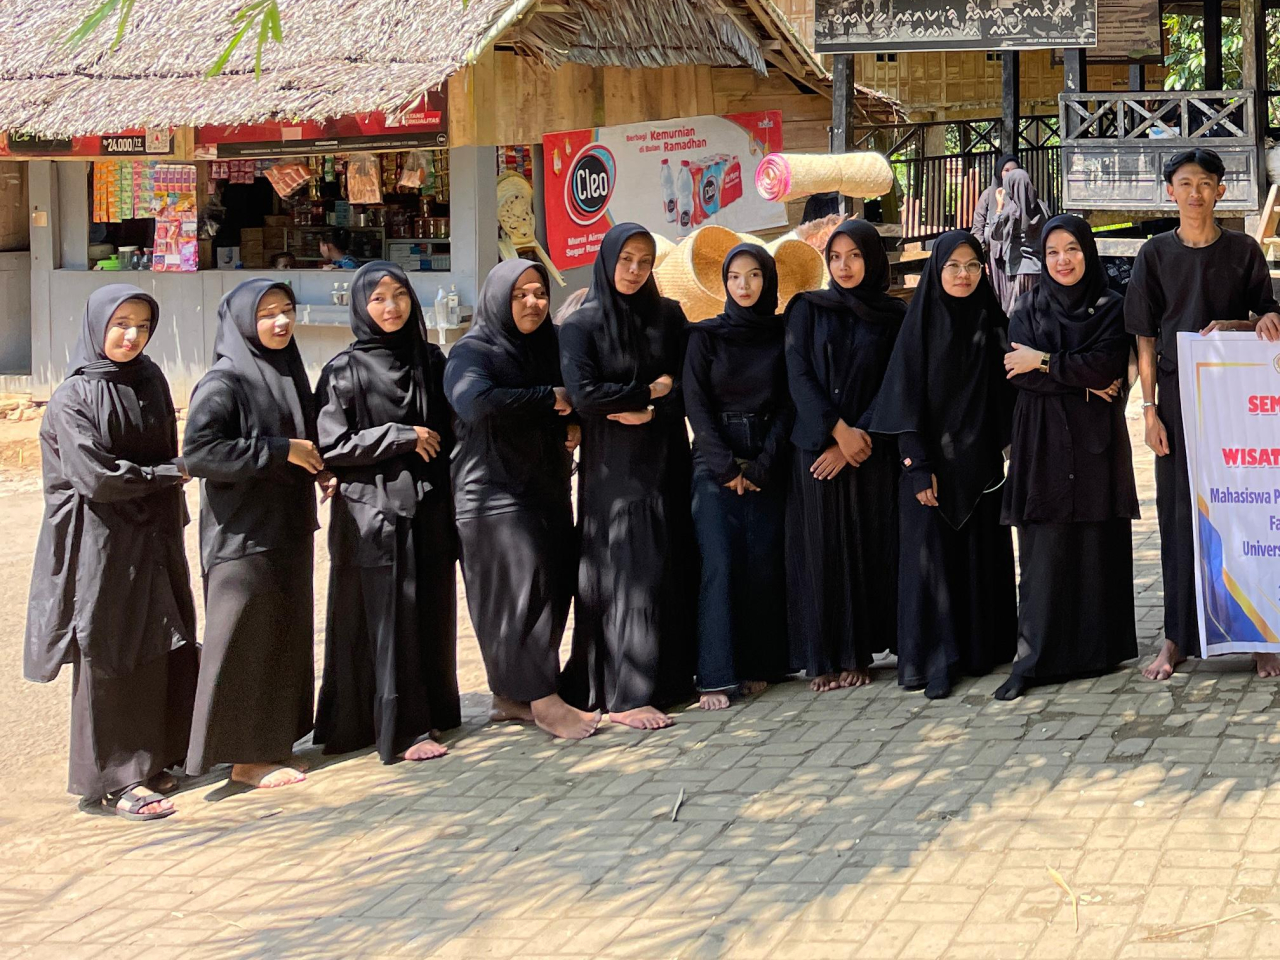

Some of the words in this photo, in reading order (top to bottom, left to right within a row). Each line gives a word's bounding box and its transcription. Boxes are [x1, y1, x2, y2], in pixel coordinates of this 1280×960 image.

[626, 132, 648, 142] Berbagi
[650, 126, 695, 140] Kemurnian
[638, 145, 645, 153] di
[645, 144, 660, 153] Bulan
[663, 138, 707, 152] Ramadhan
[576, 168, 608, 200] Cleo
[1210, 488, 1271, 506] Mahasiswa
